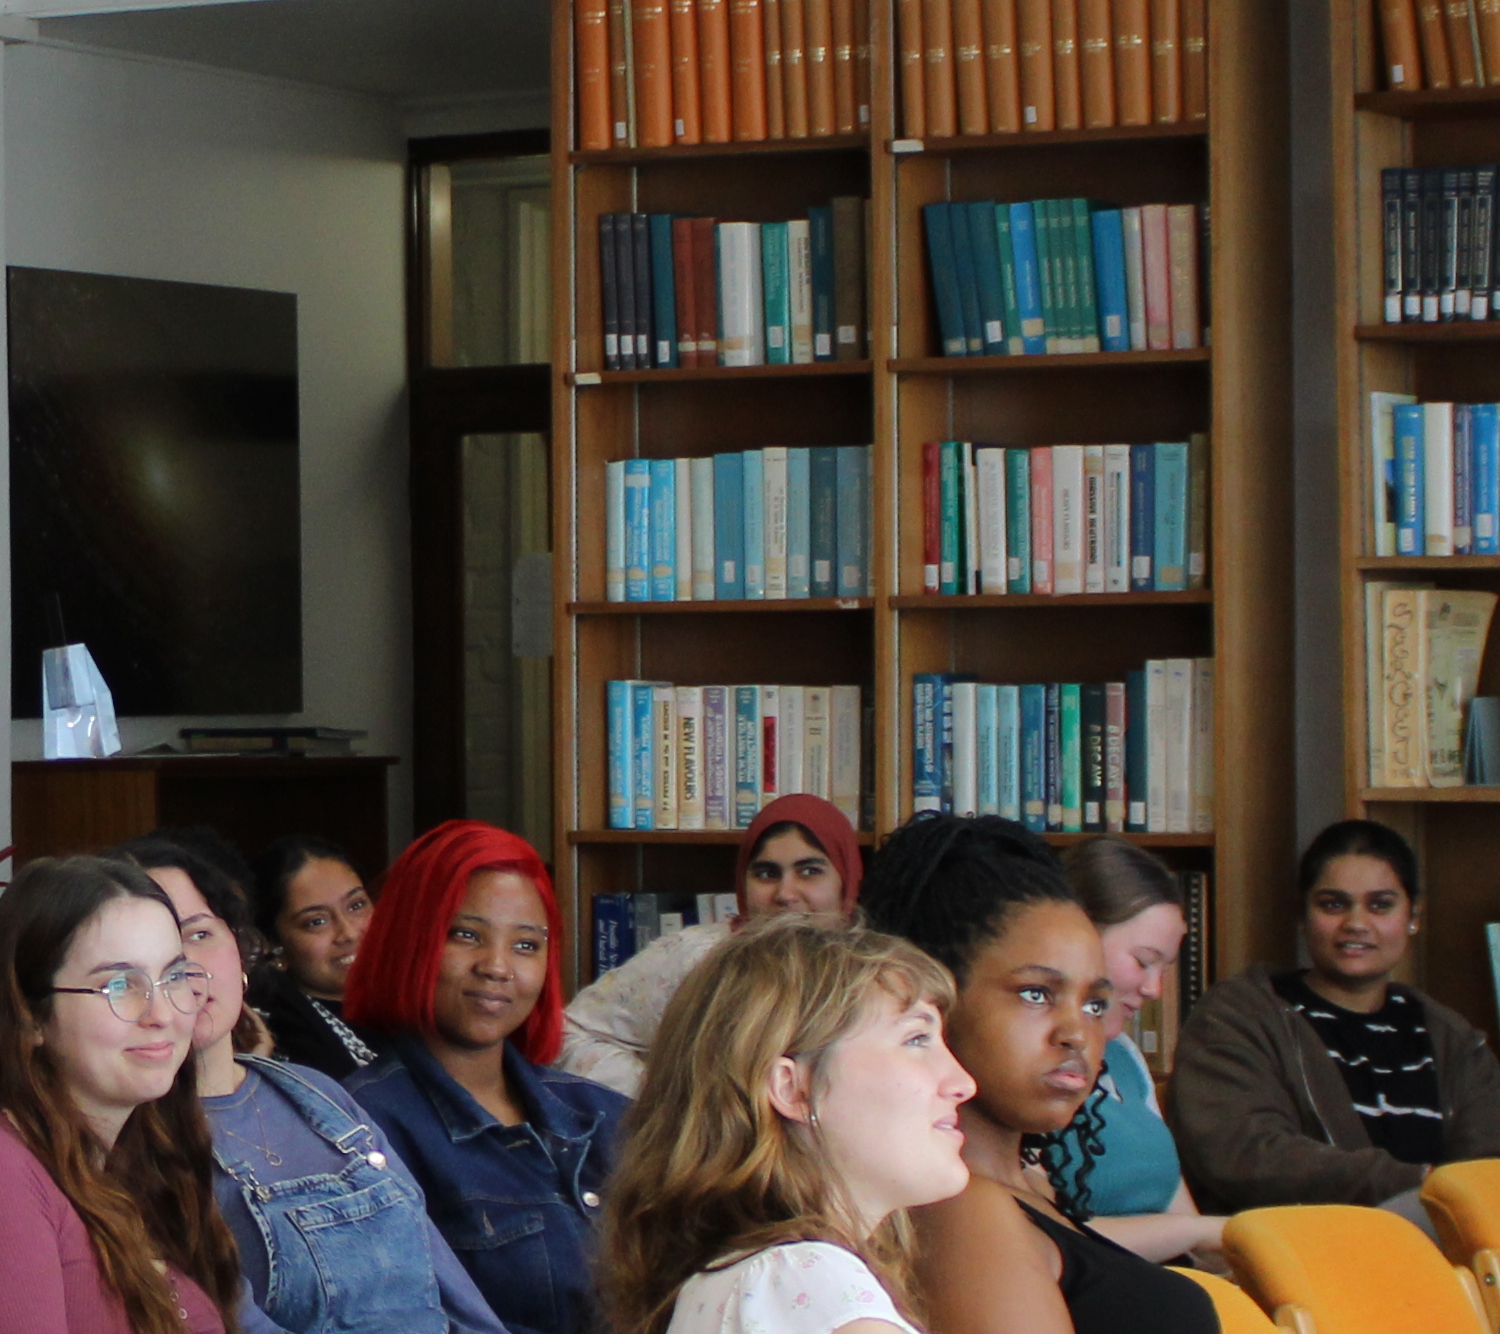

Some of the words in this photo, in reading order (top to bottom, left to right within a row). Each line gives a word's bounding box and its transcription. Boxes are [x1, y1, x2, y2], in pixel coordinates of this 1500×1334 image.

[683, 717, 695, 743] NEW
[684, 745, 697, 802] FLAVOURS
[1090, 736, 1101, 787] DECAYS
[1108, 736, 1120, 789] DECAYS
